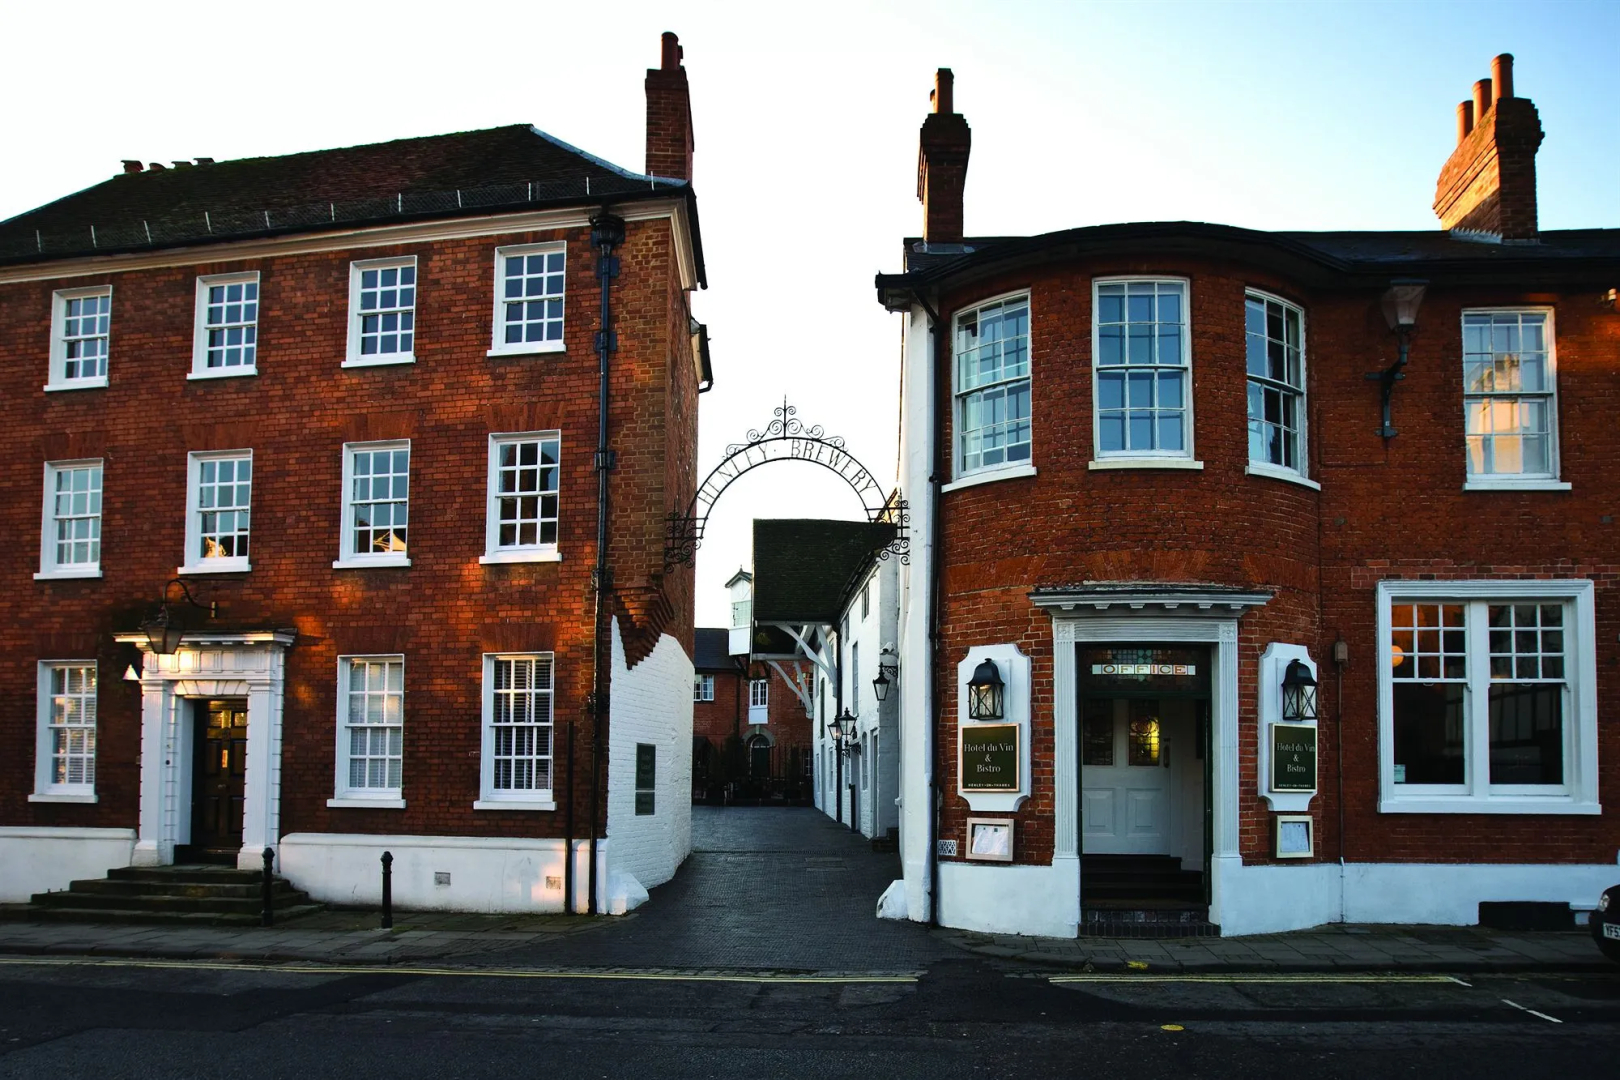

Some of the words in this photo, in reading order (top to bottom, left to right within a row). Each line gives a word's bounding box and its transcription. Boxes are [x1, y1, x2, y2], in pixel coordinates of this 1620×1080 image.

[697, 442, 768, 505] HENLEY
[791, 438, 877, 493] BREWERY
[1103, 665, 1186, 675] OFFICE
[964, 743, 986, 752] Hotel
[987, 743, 998, 752] du
[999, 742, 1014, 752] Vin
[1277, 742, 1295, 752] Hotel
[1295, 743, 1304, 752] du
[1304, 743, 1315, 752] Vin
[984, 753, 992, 762] &
[1292, 753, 1300, 762] &
[976, 764, 1001, 772] Bistro
[1287, 764, 1306, 773] Bistro
